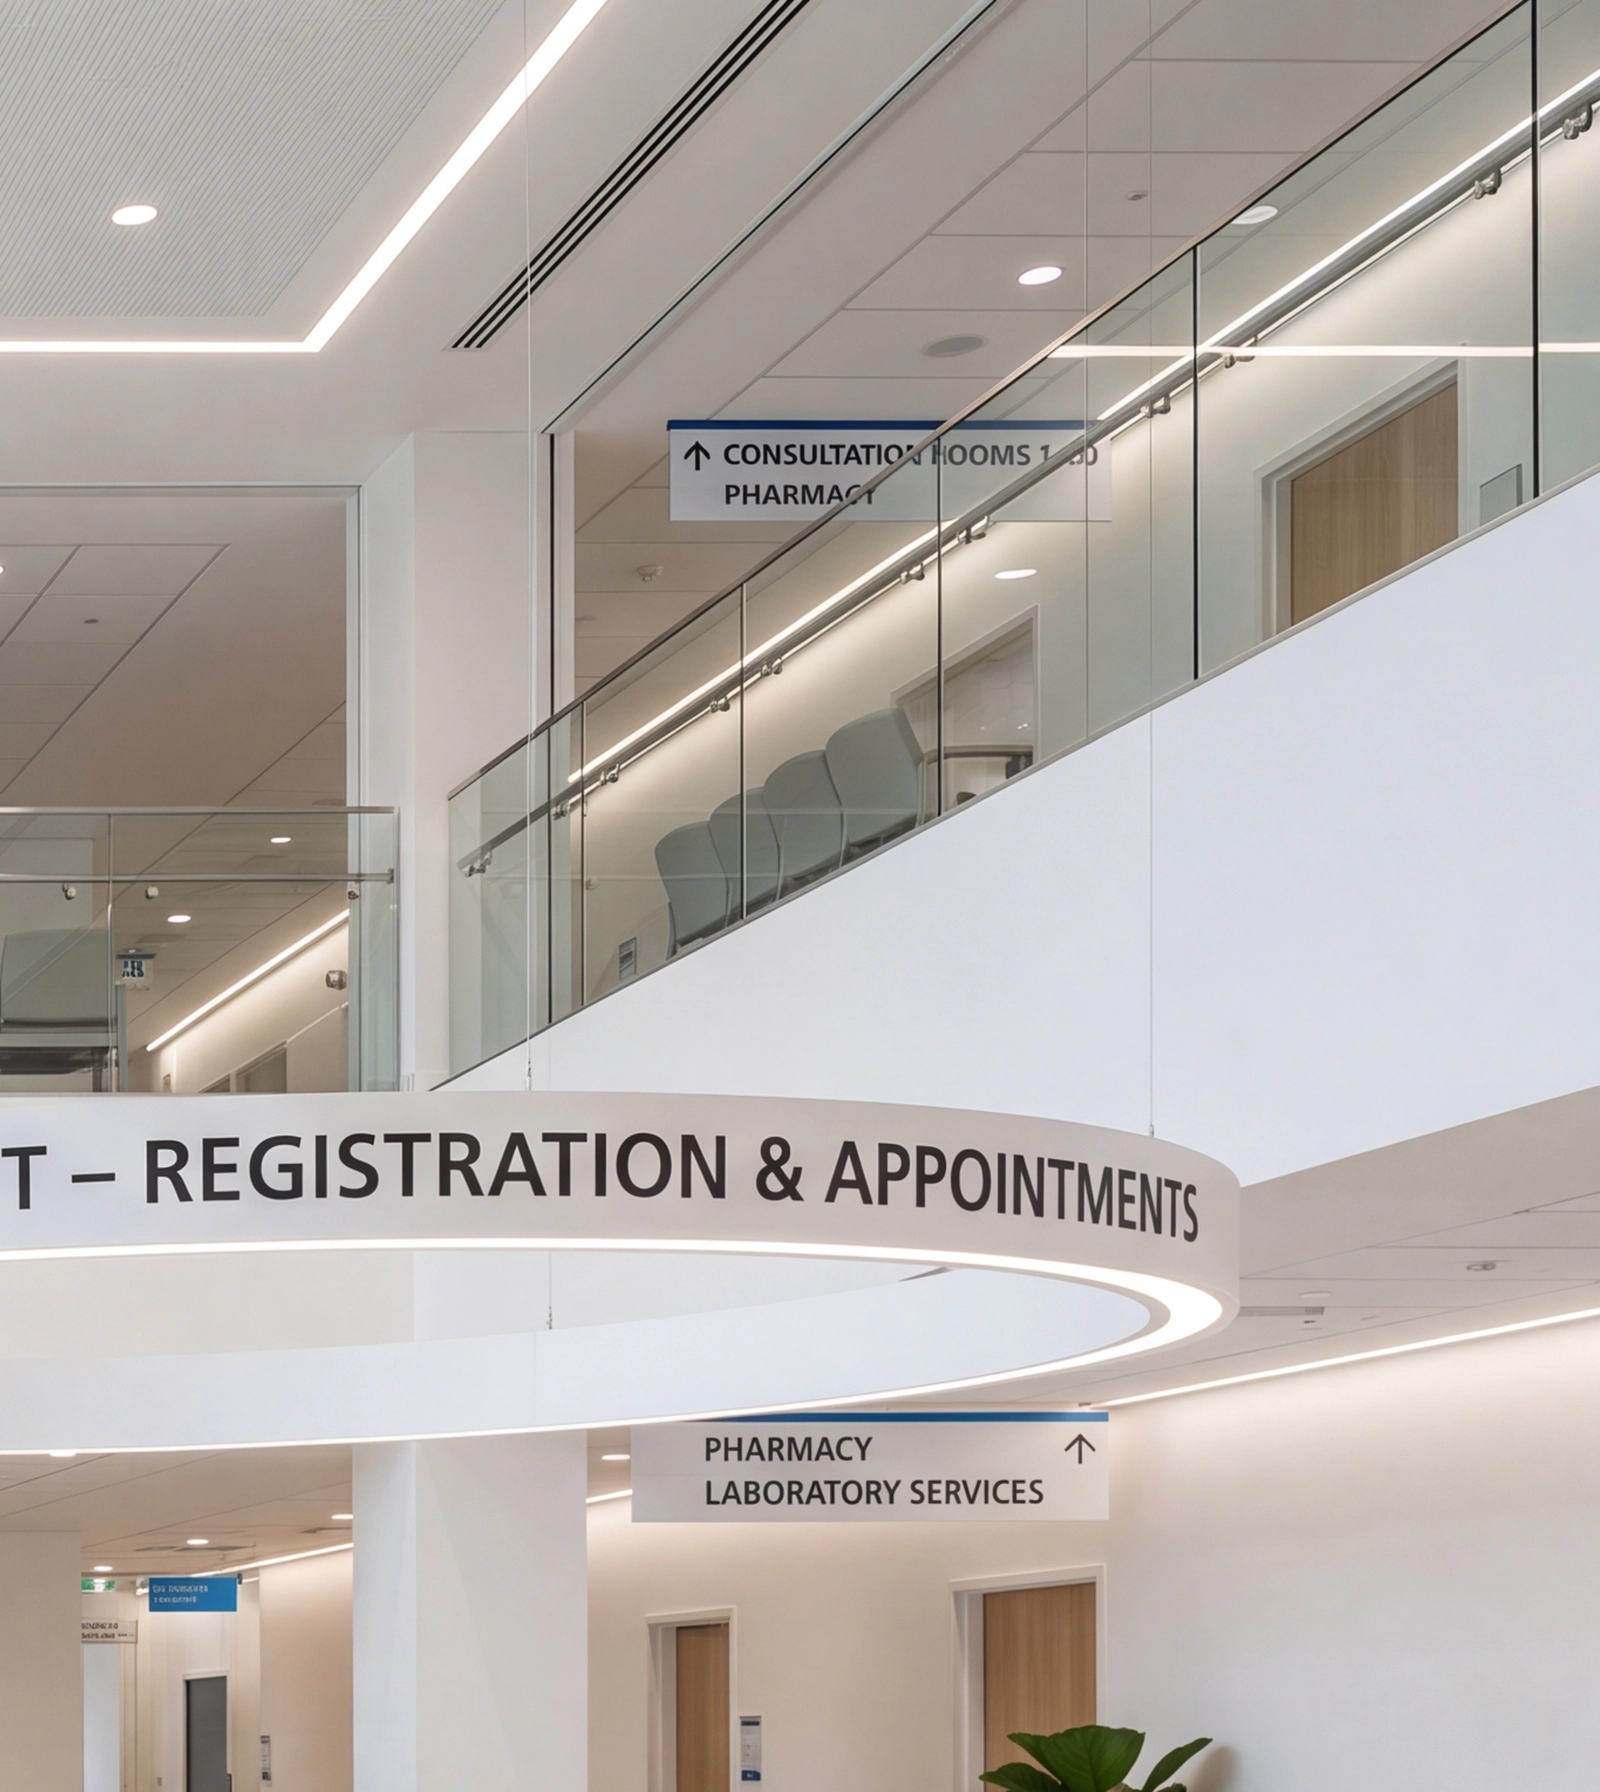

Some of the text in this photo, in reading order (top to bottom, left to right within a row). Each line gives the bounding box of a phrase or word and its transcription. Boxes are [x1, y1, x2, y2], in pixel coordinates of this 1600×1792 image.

[146, 1132, 726, 1204] REGISTRATION
[755, 1136, 805, 1202] &
[824, 1140, 1199, 1243] APPOINTMENTS
[705, 1436, 873, 1462] PHARMACY
[705, 1479, 1044, 1506] LABORATORY SERVICES
